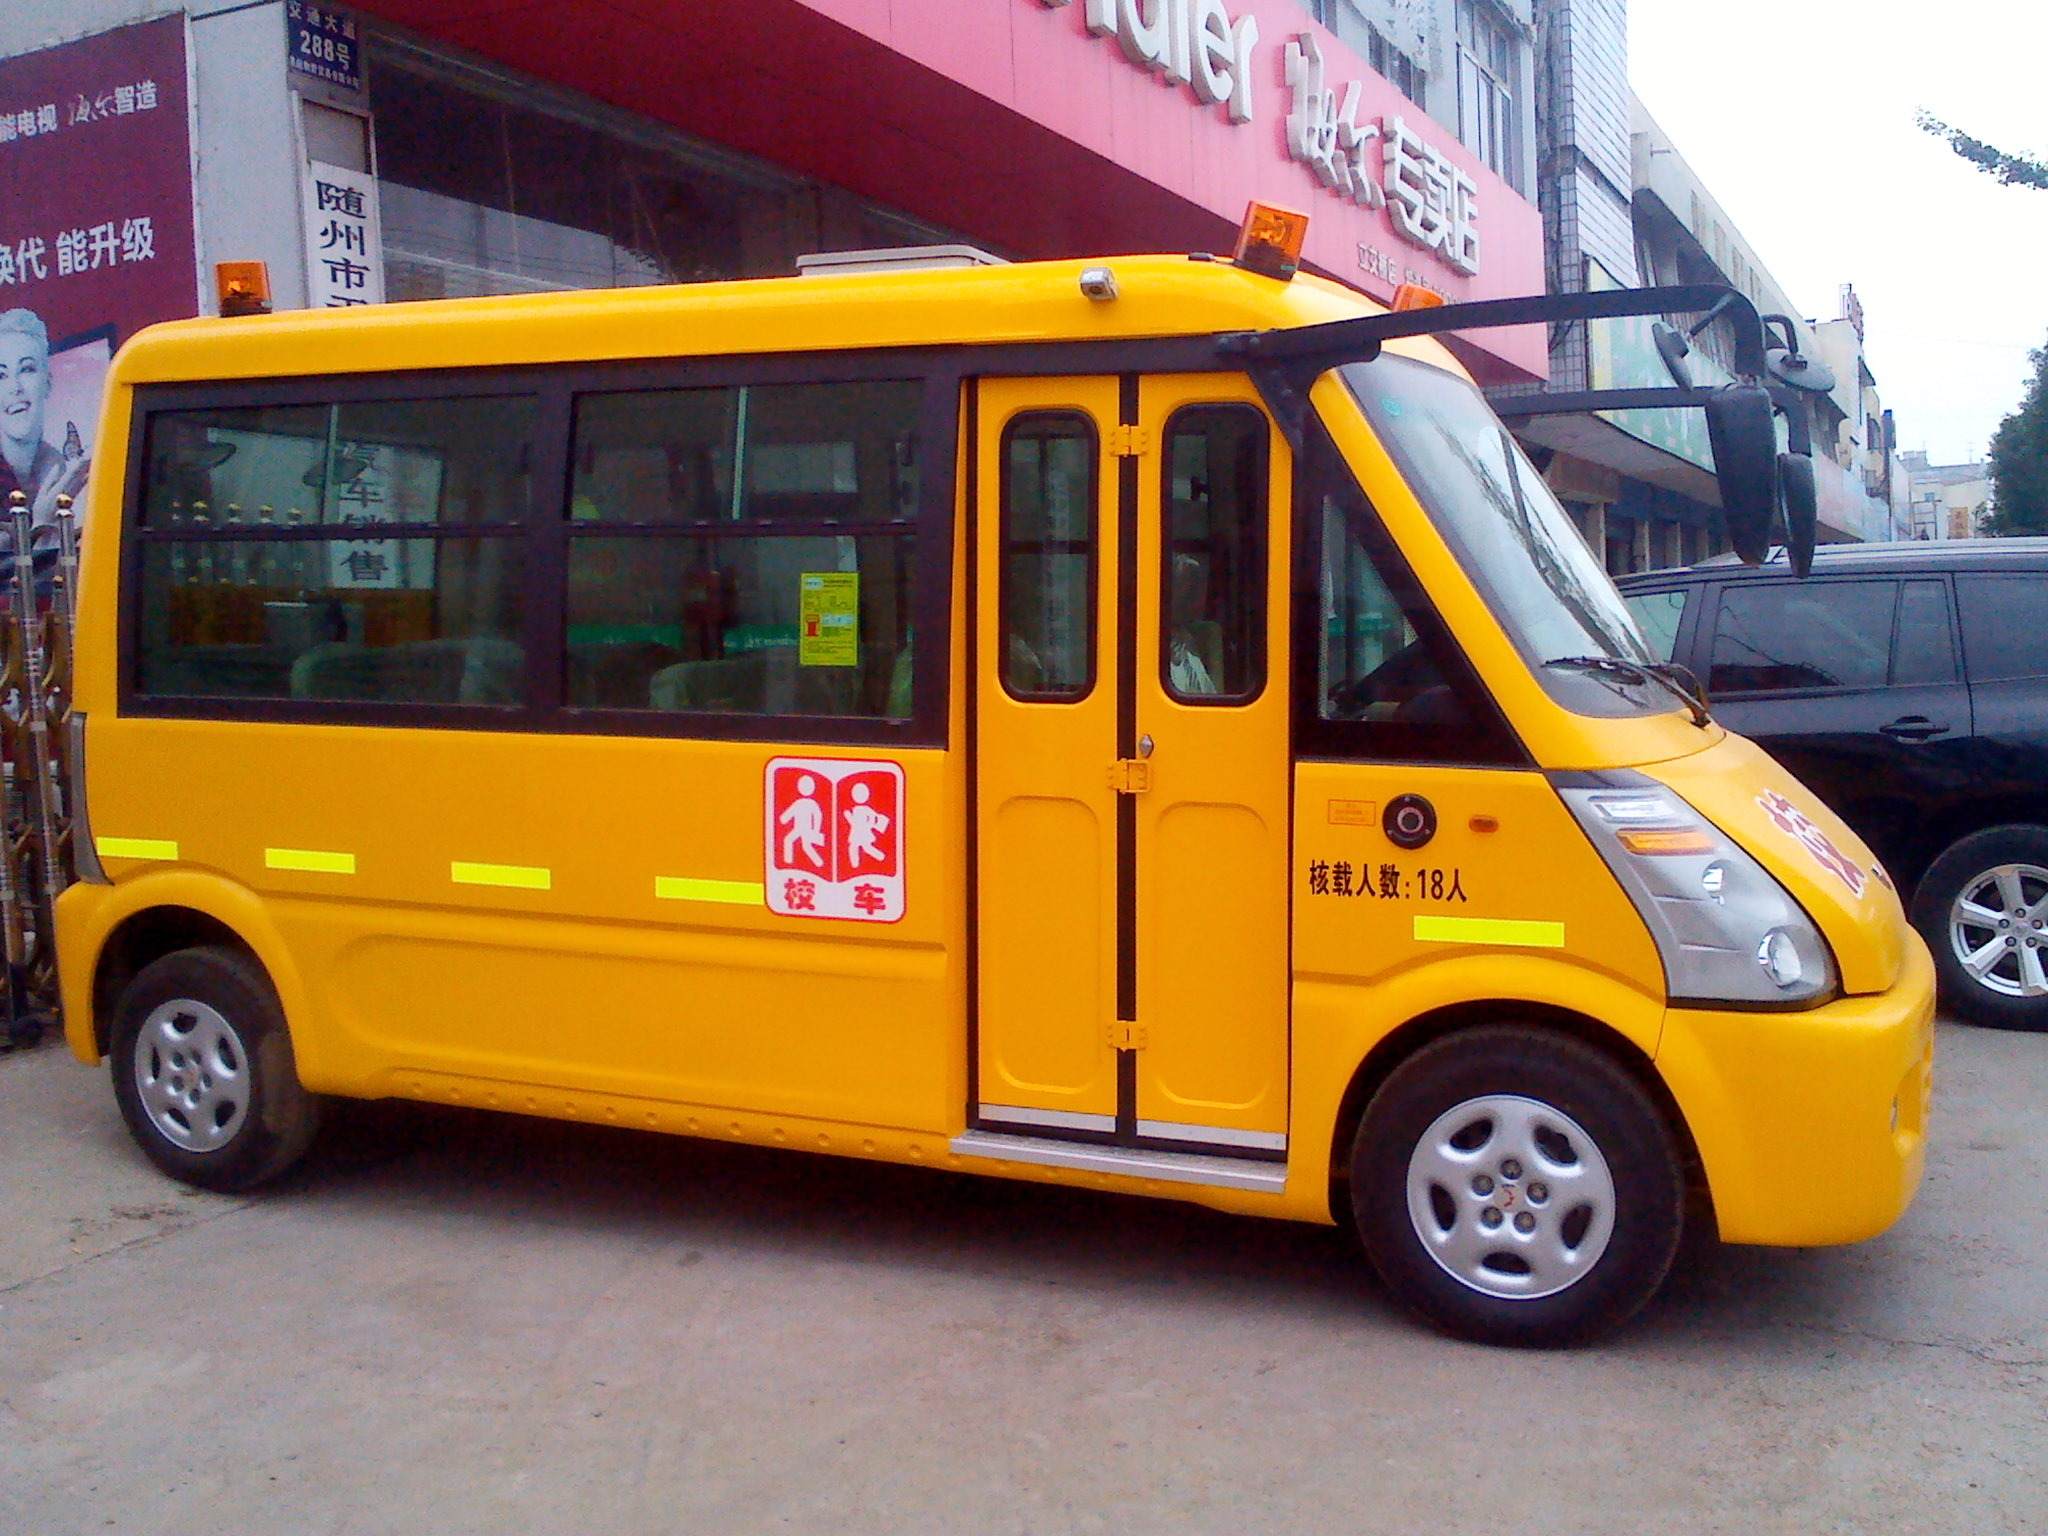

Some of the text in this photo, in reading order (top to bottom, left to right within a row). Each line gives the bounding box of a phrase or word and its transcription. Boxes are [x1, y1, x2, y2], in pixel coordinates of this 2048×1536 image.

[300, 30, 350, 71] 288号
[1037, 0, 1259, 125] aier
[56, 217, 155, 276] 能升级
[784, 878, 886, 914] 校车
